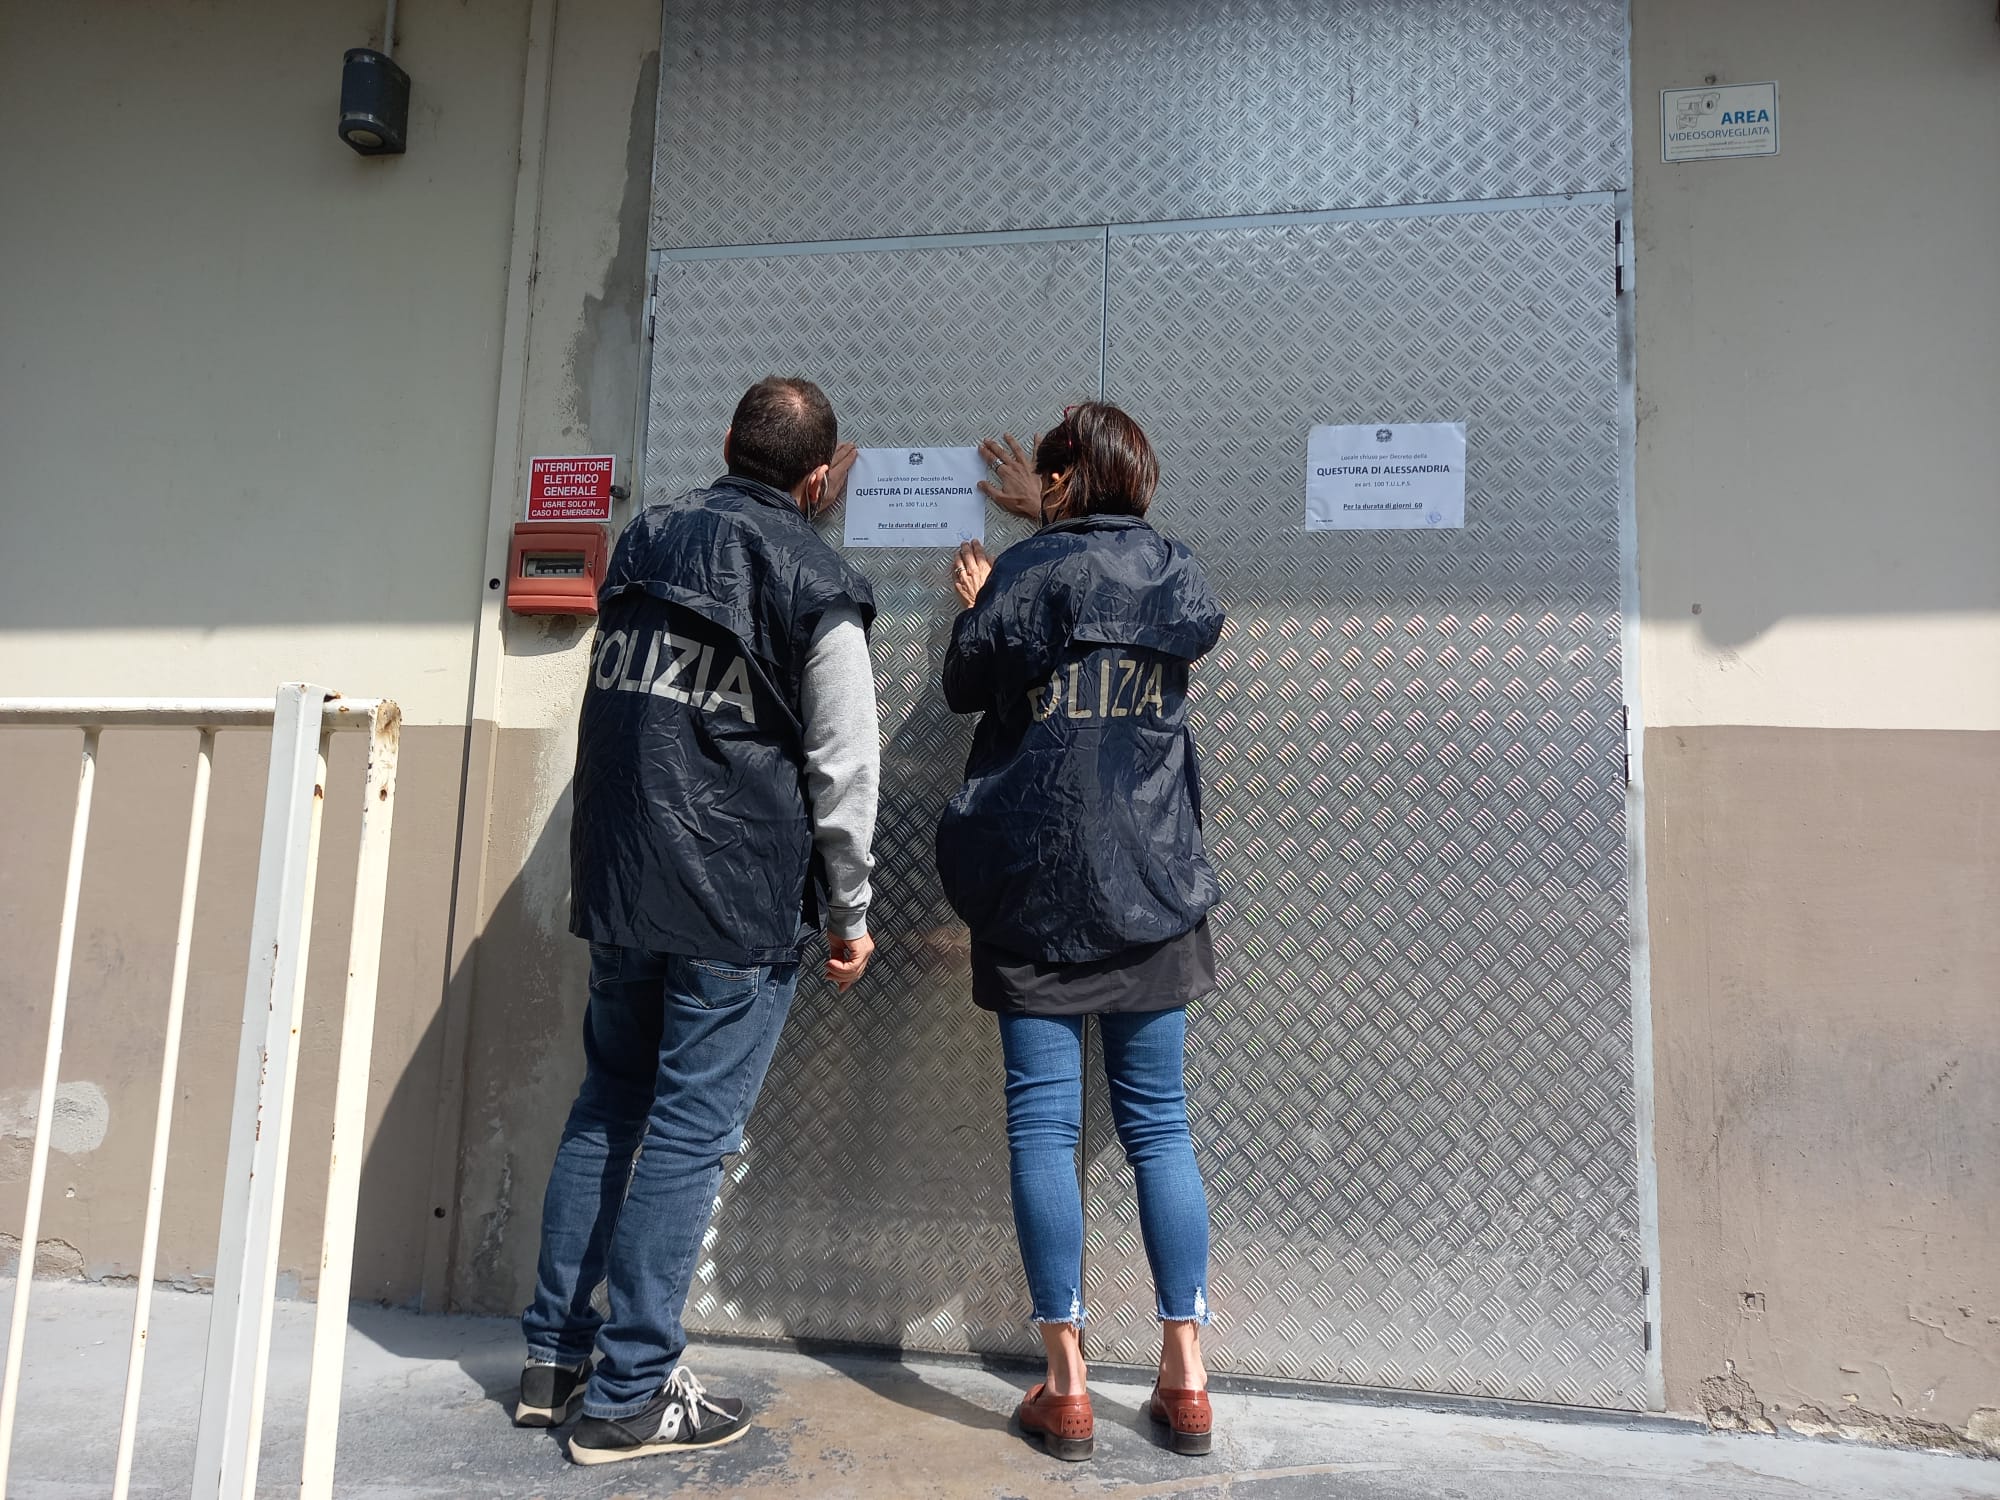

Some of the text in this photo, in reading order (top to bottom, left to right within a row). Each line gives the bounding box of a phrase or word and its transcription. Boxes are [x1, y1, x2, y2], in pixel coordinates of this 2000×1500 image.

[1721, 109, 1769, 125] AREA
[1669, 127, 1770, 141] VIDEOSORVEGLIATA
[534, 462, 610, 472] INTERRUTTORE
[1317, 464, 1450, 476] QUESTURA DI ALESSANDRIA
[544, 474, 598, 484] ELETTRICO
[544, 486, 597, 496] GENERALE
[856, 488, 901, 496] QUESTURA
[915, 487, 973, 495] ALESSANDRIA
[1027, 659, 1163, 722] OLIZIA
